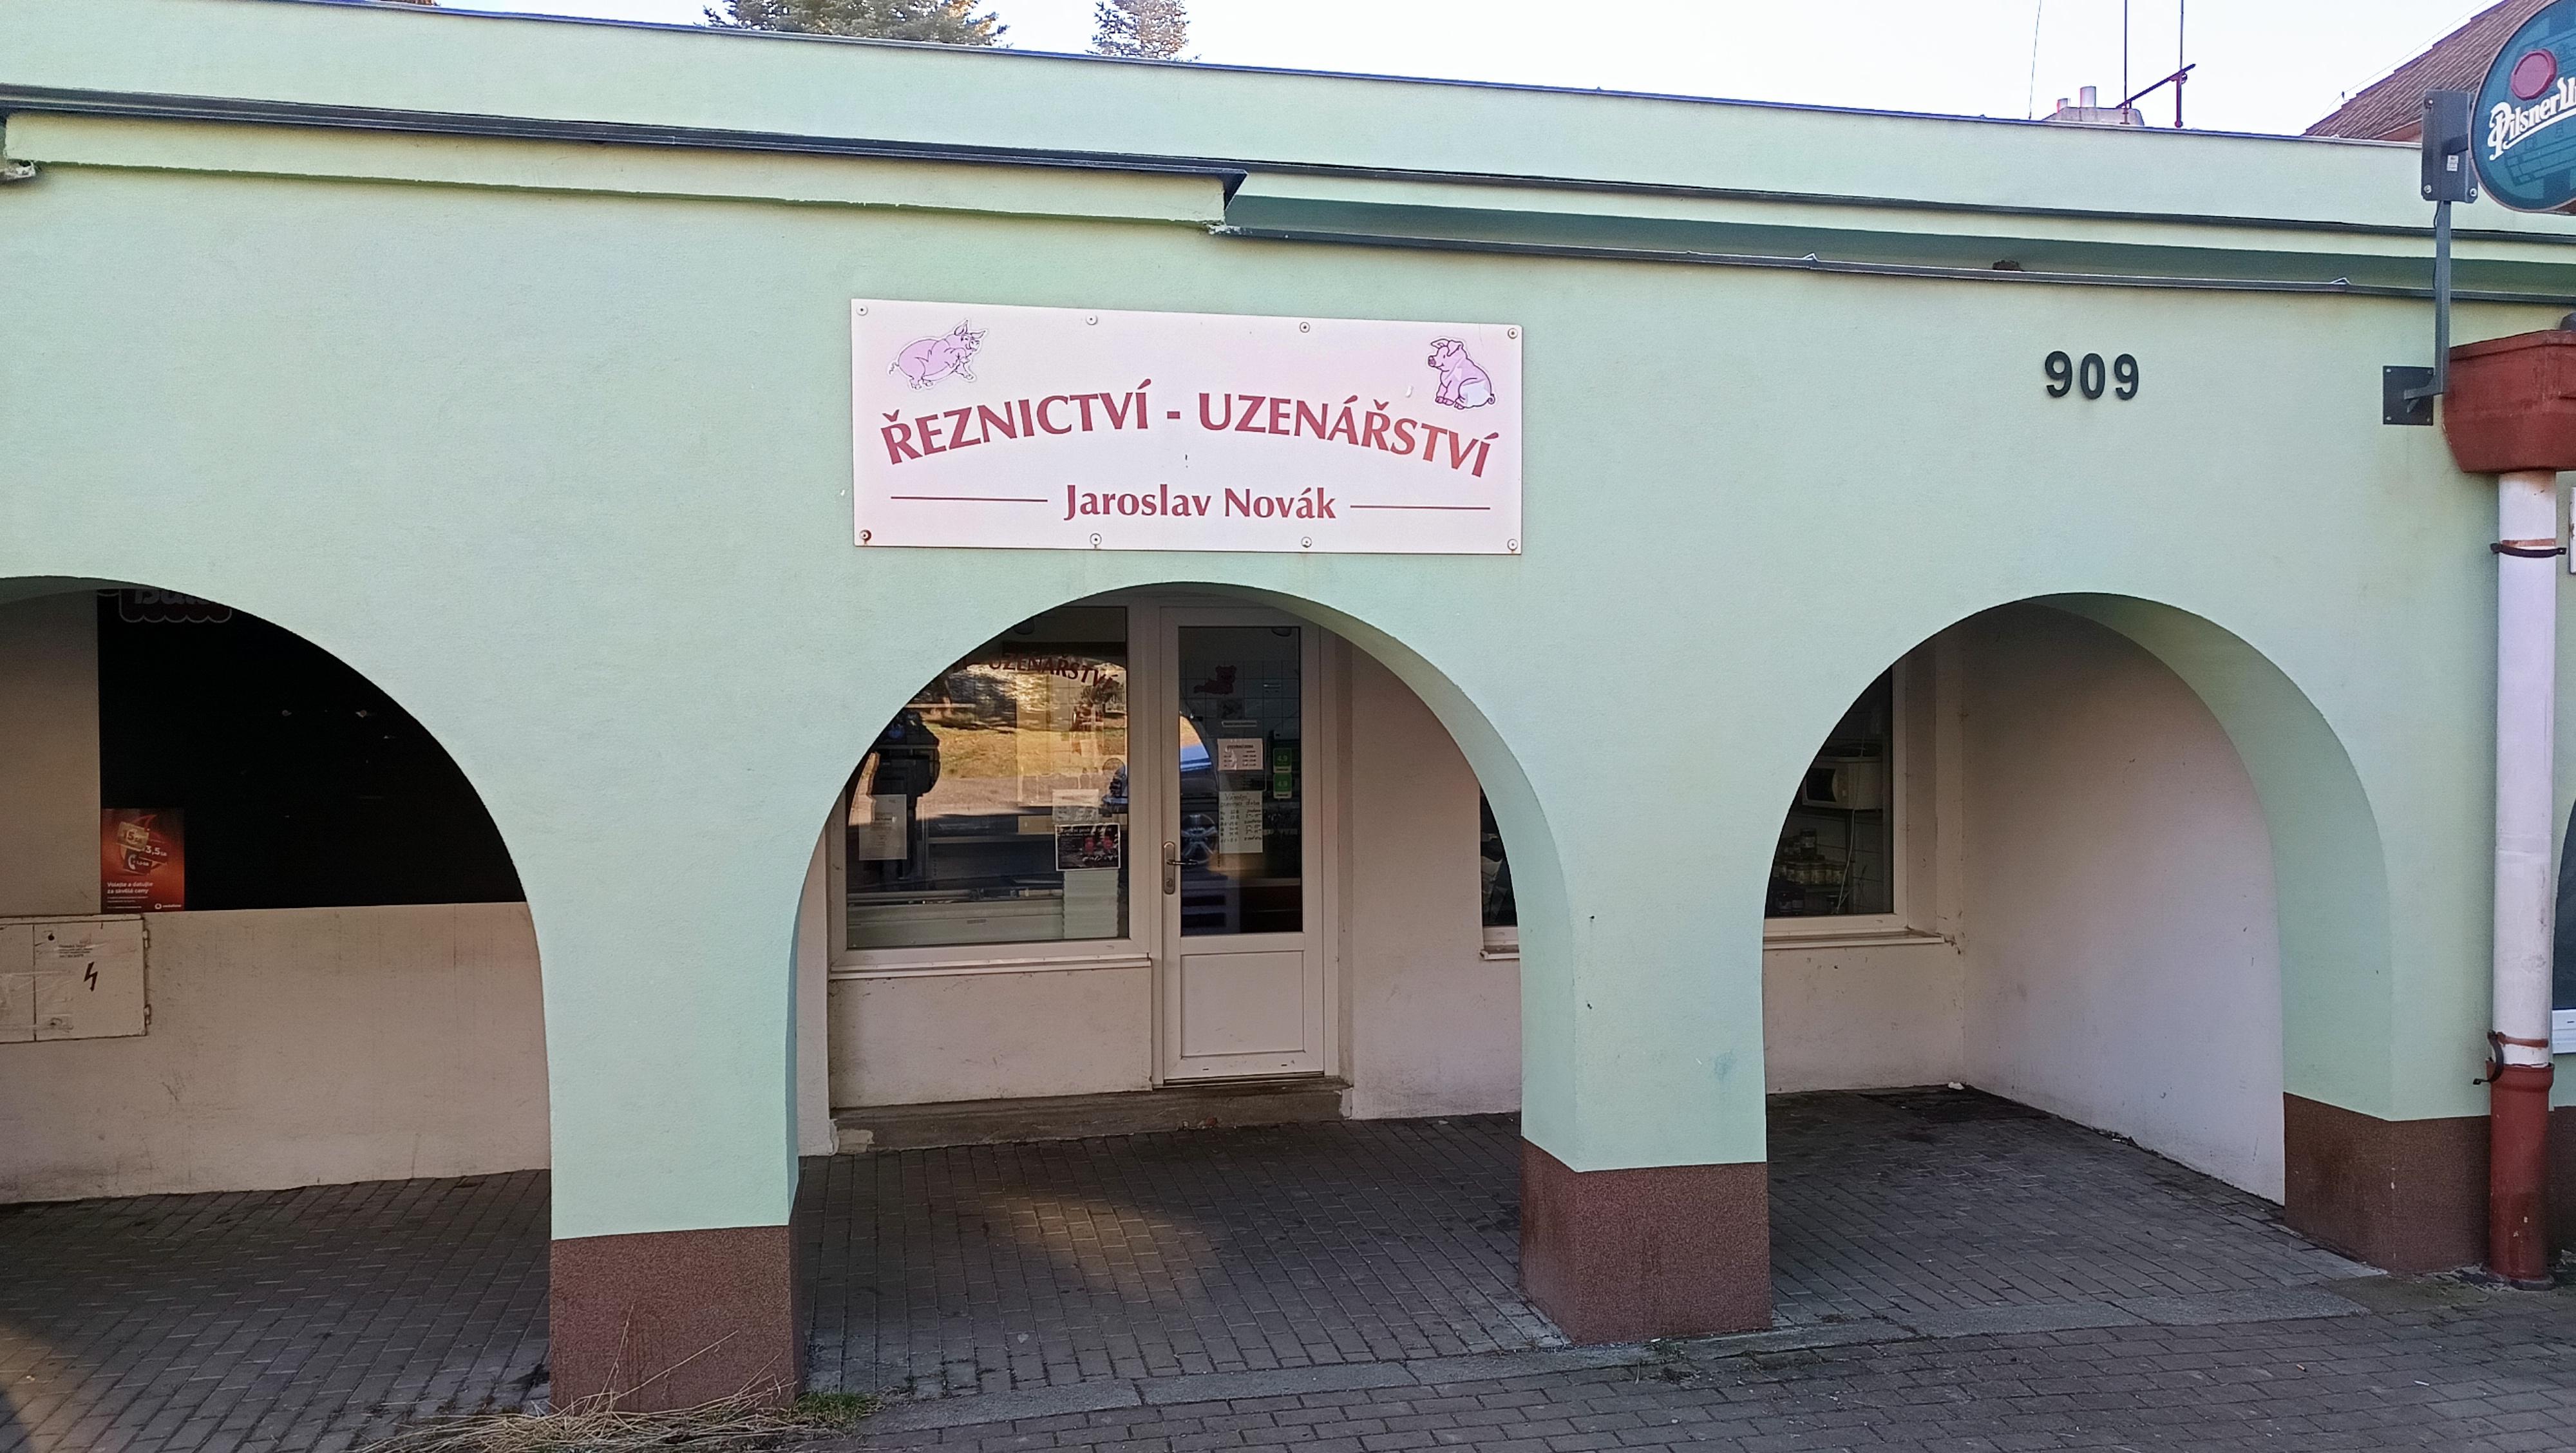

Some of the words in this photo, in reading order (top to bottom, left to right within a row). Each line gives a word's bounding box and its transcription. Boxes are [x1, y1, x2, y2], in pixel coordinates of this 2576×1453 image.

[2488, 93, 2561, 161] Pilsner
[2045, 350, 2139, 400] 909
[882, 379, 1151, 464] ŘEZNICTVÍ
[1167, 412, 1181, 420] -
[1200, 393, 1499, 477] UZENÁŘSTVÍ
[1065, 484, 1211, 520] Jaroslav
[1225, 488, 1336, 518] Novák
